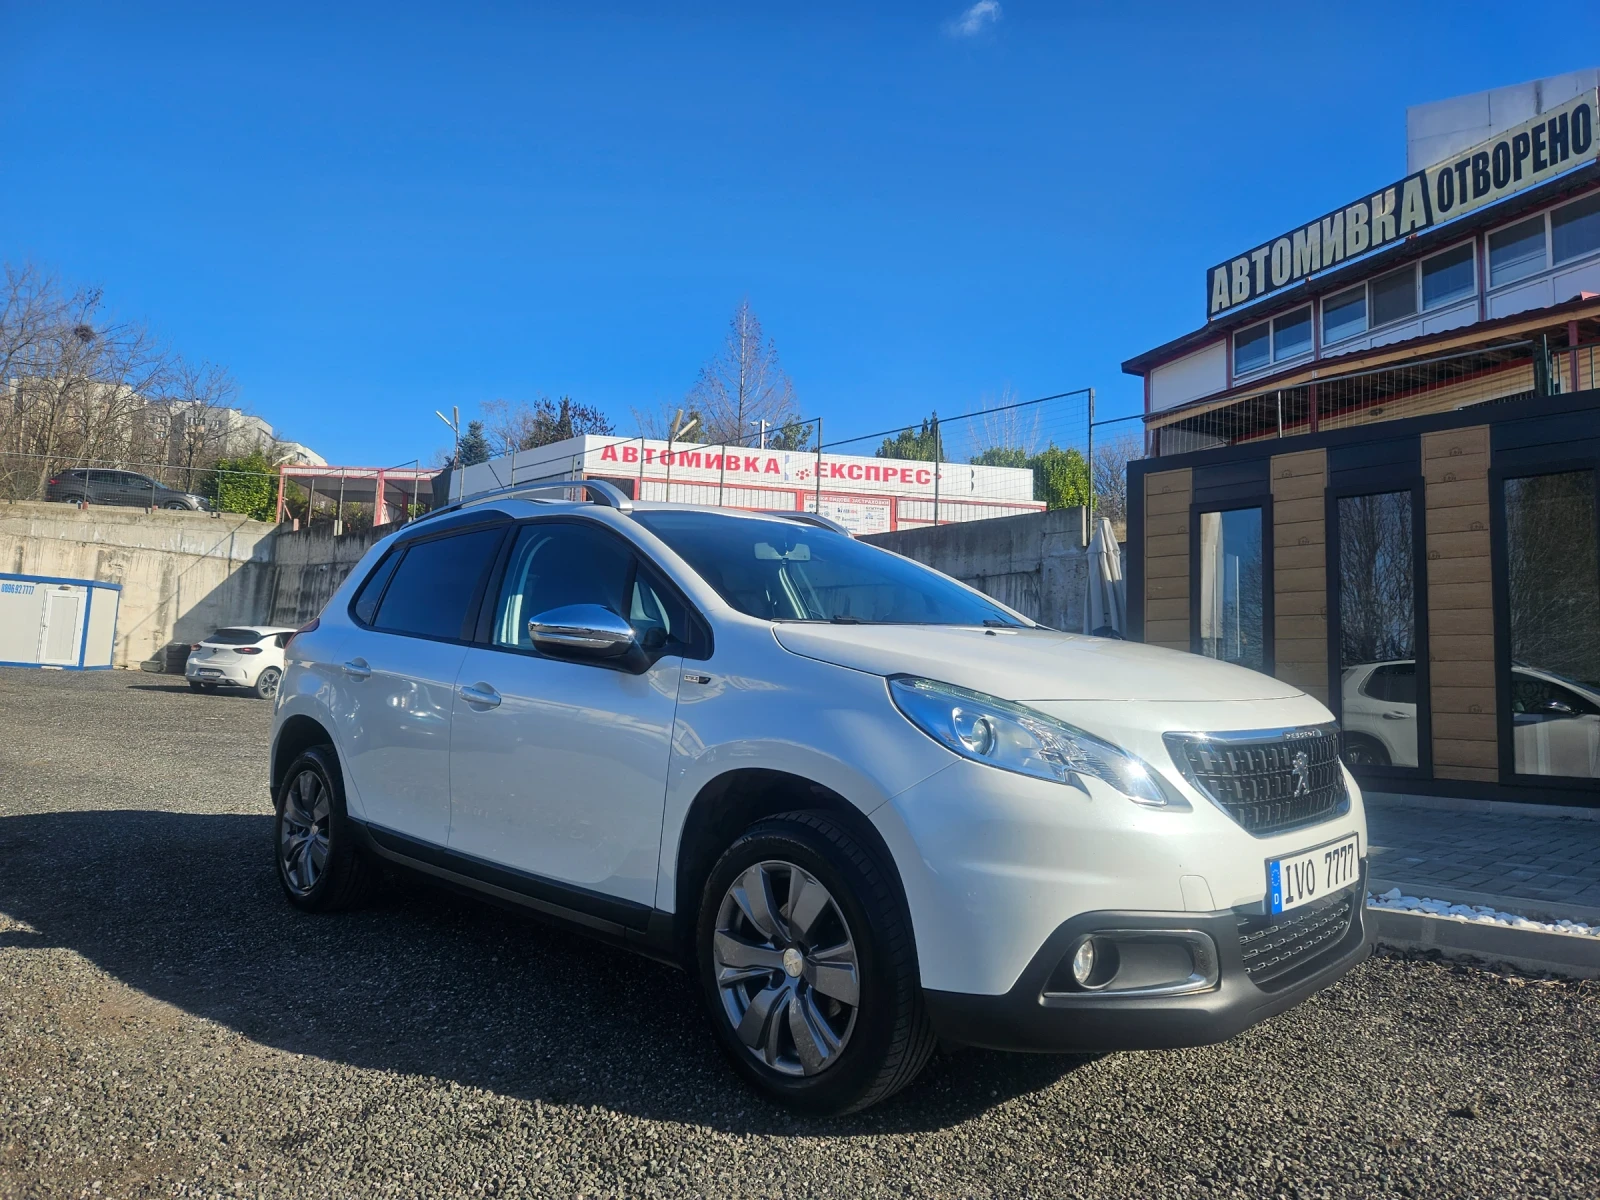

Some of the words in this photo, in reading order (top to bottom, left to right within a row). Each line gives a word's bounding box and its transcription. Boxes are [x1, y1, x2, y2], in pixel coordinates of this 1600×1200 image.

[1210, 176, 1427, 314] АВТОМИВКА
[1436, 102, 1593, 214] ОТВОРЕНО
[600, 444, 781, 475] АВТОМИВКА
[814, 461, 931, 485] ЕКСПРЕС
[1274, 893, 1279, 905] D
[1285, 859, 1316, 905] IVO
[1324, 843, 1354, 889] 7777
